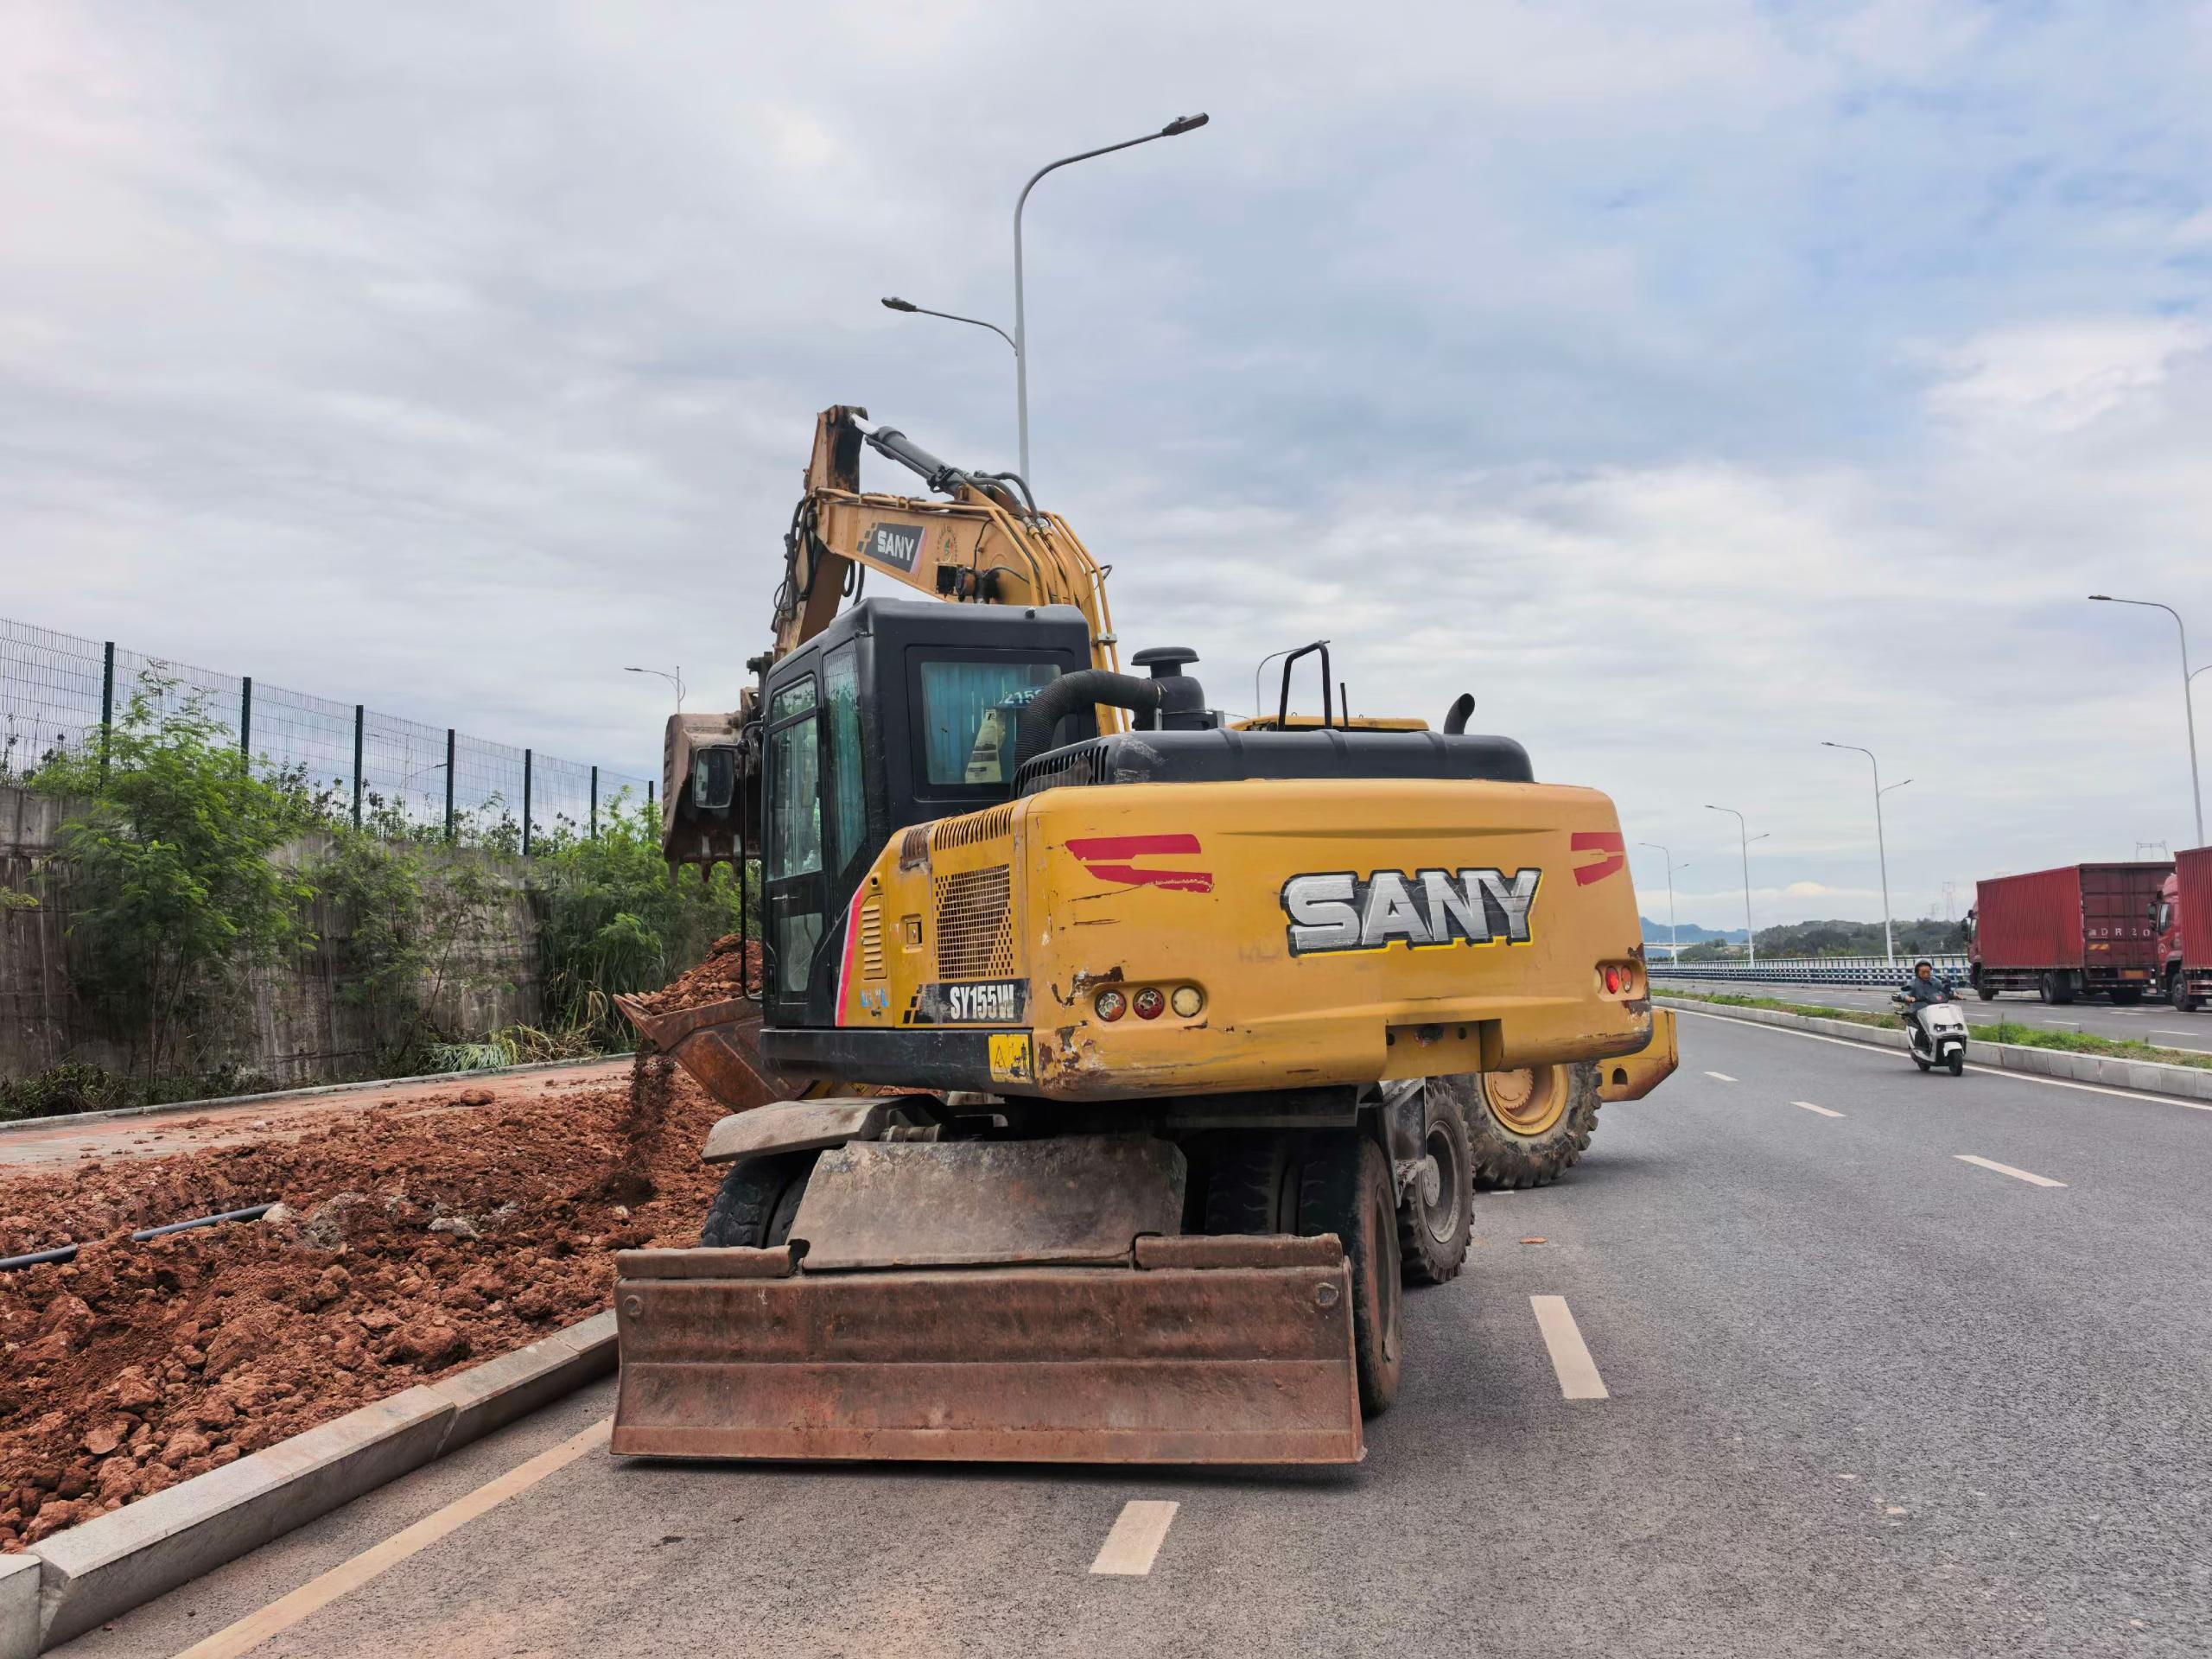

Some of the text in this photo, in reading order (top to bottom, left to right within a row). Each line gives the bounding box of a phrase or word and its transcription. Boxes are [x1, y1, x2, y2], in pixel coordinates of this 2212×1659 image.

[878, 530, 914, 561] SANY
[1281, 868, 1541, 956] SANY
[950, 984, 1014, 1020] SY155W
